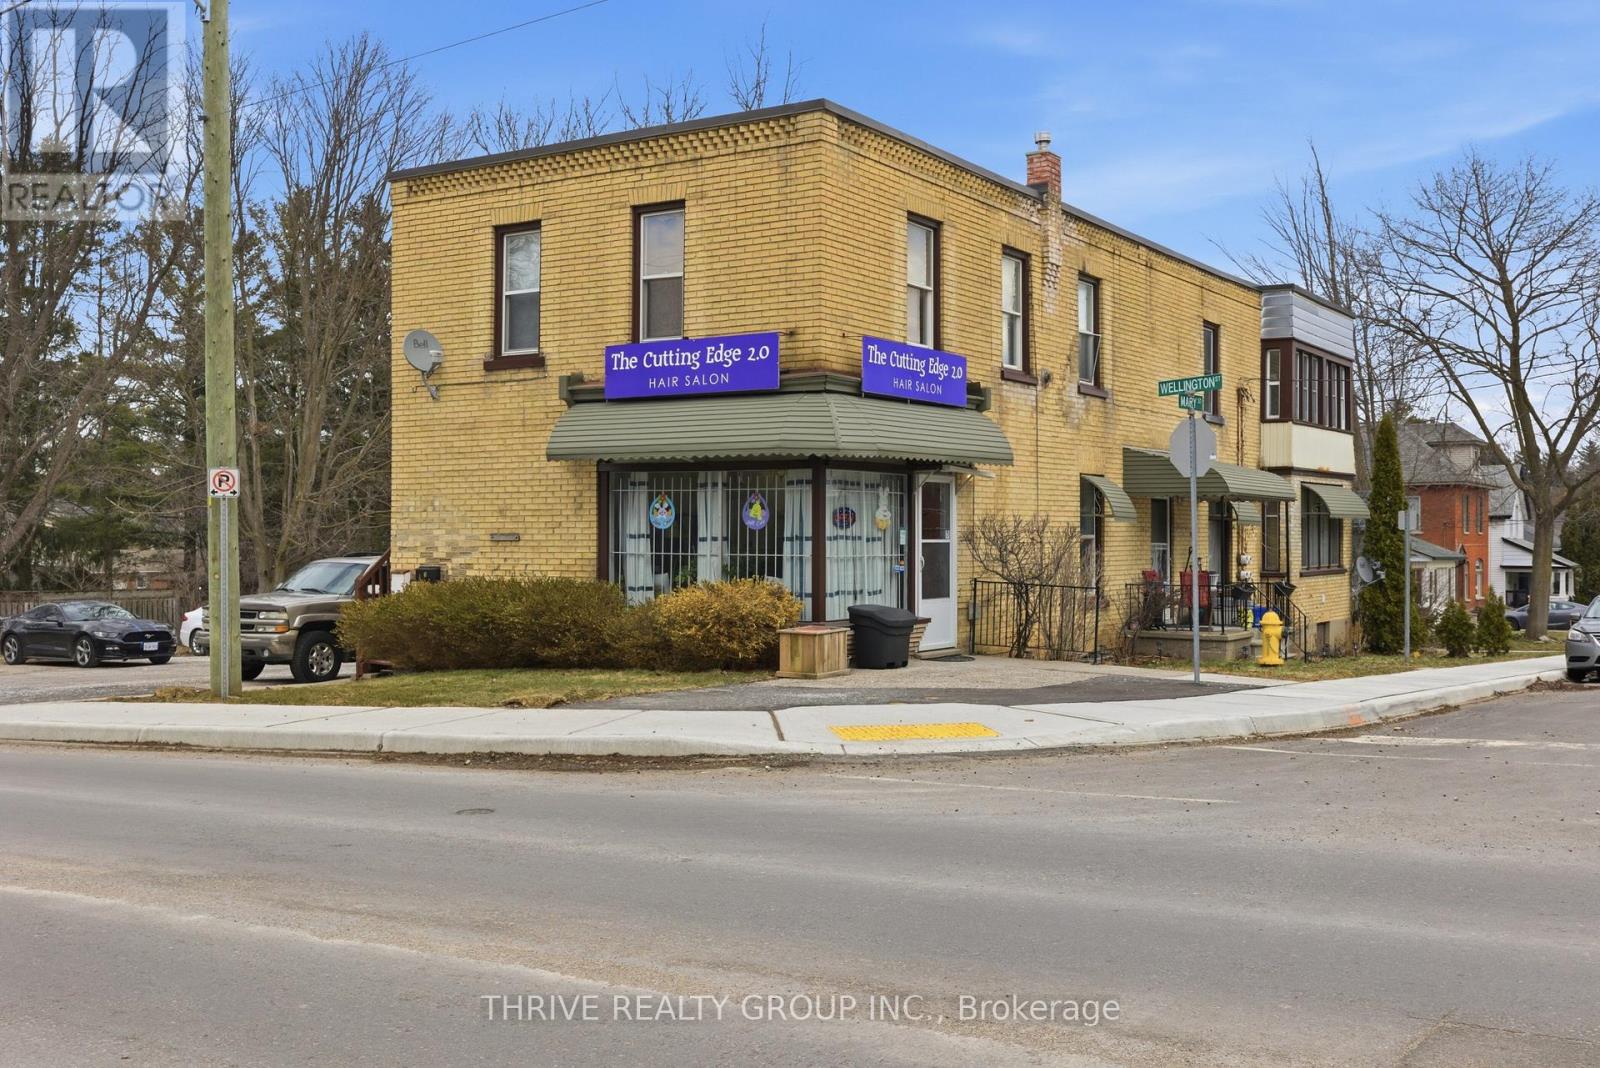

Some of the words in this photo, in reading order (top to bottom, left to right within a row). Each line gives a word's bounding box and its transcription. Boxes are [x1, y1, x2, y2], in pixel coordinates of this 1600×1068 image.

[413, 339, 428, 348] Bell
[611, 351, 638, 371] The
[643, 348, 701, 370] Cutting
[705, 343, 742, 368] Edge
[747, 345, 770, 362] 2.0
[867, 344, 887, 365] The
[889, 350, 926, 377] Cutting
[928, 356, 949, 381] Edge
[951, 365, 963, 380] 2.0
[648, 376, 679, 389] HAIR
[684, 373, 729, 387] SALON
[893, 377, 913, 391] HAIR
[915, 380, 942, 395] SALON
[1160, 376, 1215, 395] WELLINGTON
[1180, 395, 1197, 409] MARY
